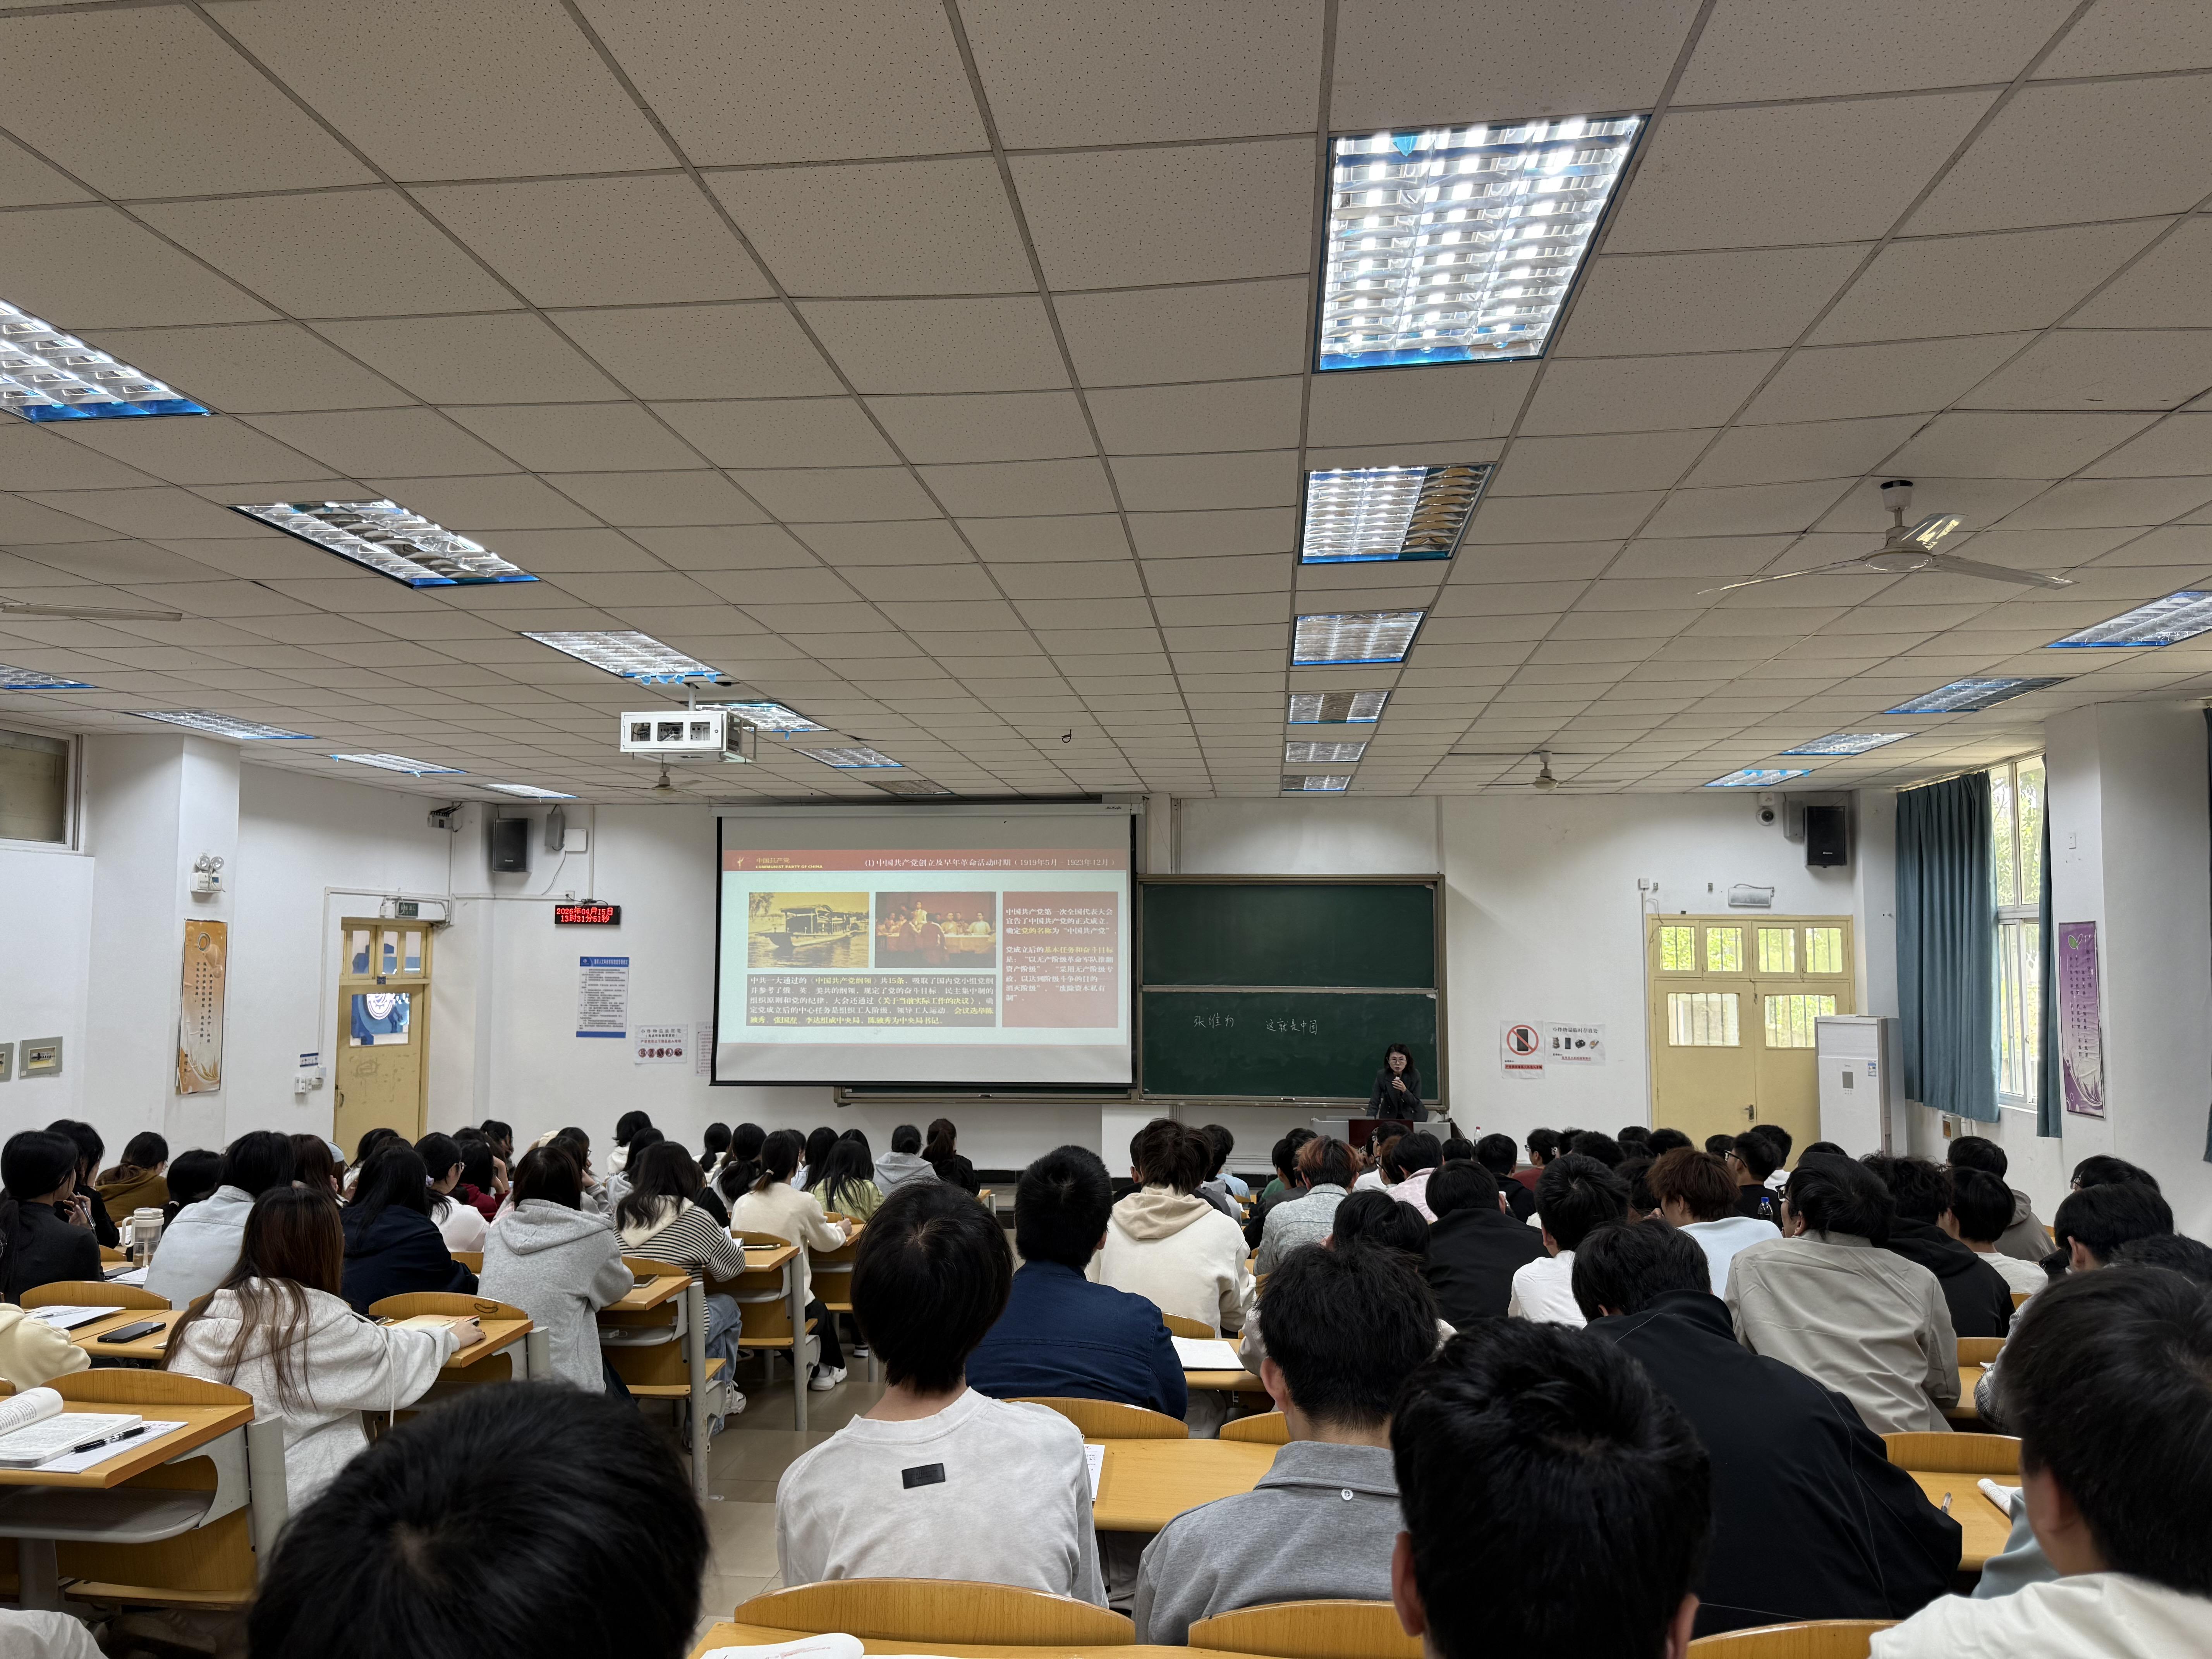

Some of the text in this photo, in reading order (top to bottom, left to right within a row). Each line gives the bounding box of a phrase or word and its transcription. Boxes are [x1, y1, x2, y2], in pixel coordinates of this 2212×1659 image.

[556, 906, 613, 915] 2026年04月15日
[1194, 1013, 1317, 1035] 张维为 这就是中国
